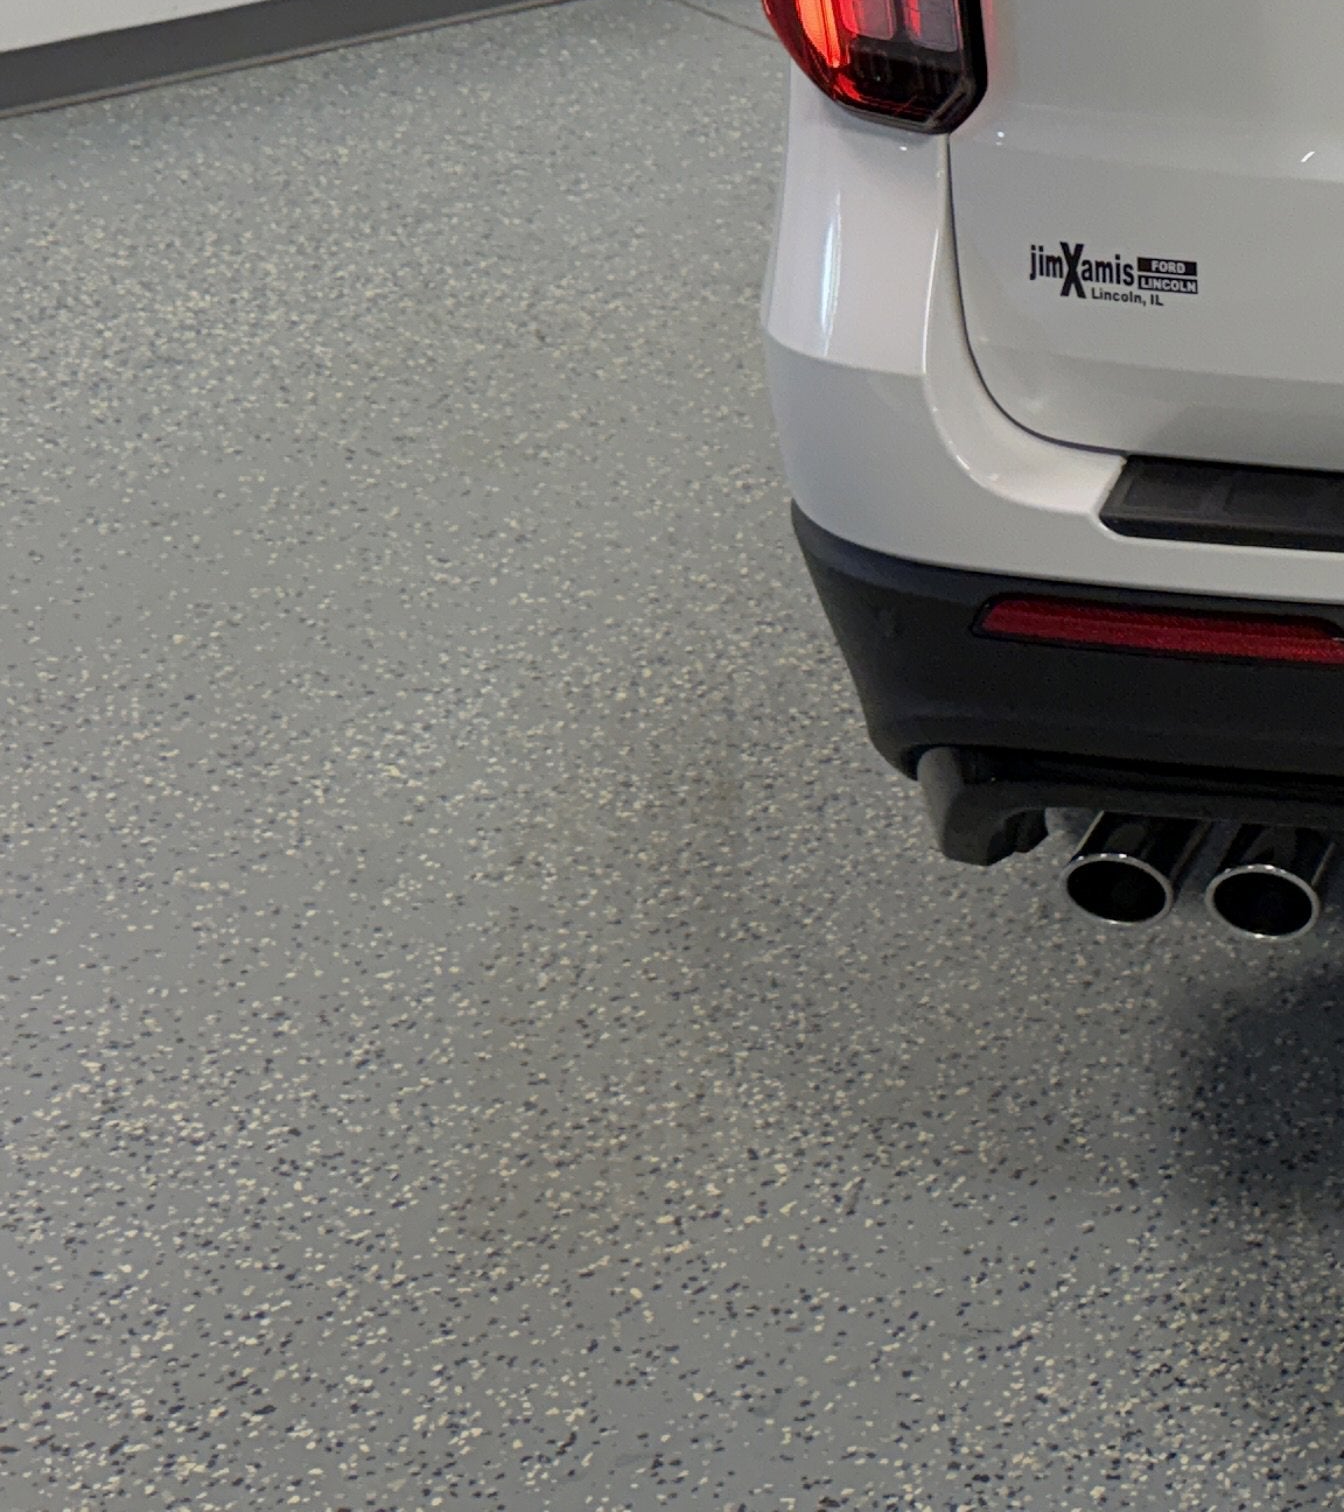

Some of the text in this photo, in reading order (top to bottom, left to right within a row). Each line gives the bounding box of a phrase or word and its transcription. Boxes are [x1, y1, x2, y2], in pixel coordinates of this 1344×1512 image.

[1151, 260, 1186, 274] FORD
[1141, 277, 1197, 292] LINCOLN
[1091, 287, 1164, 307] Lincoln, IL
